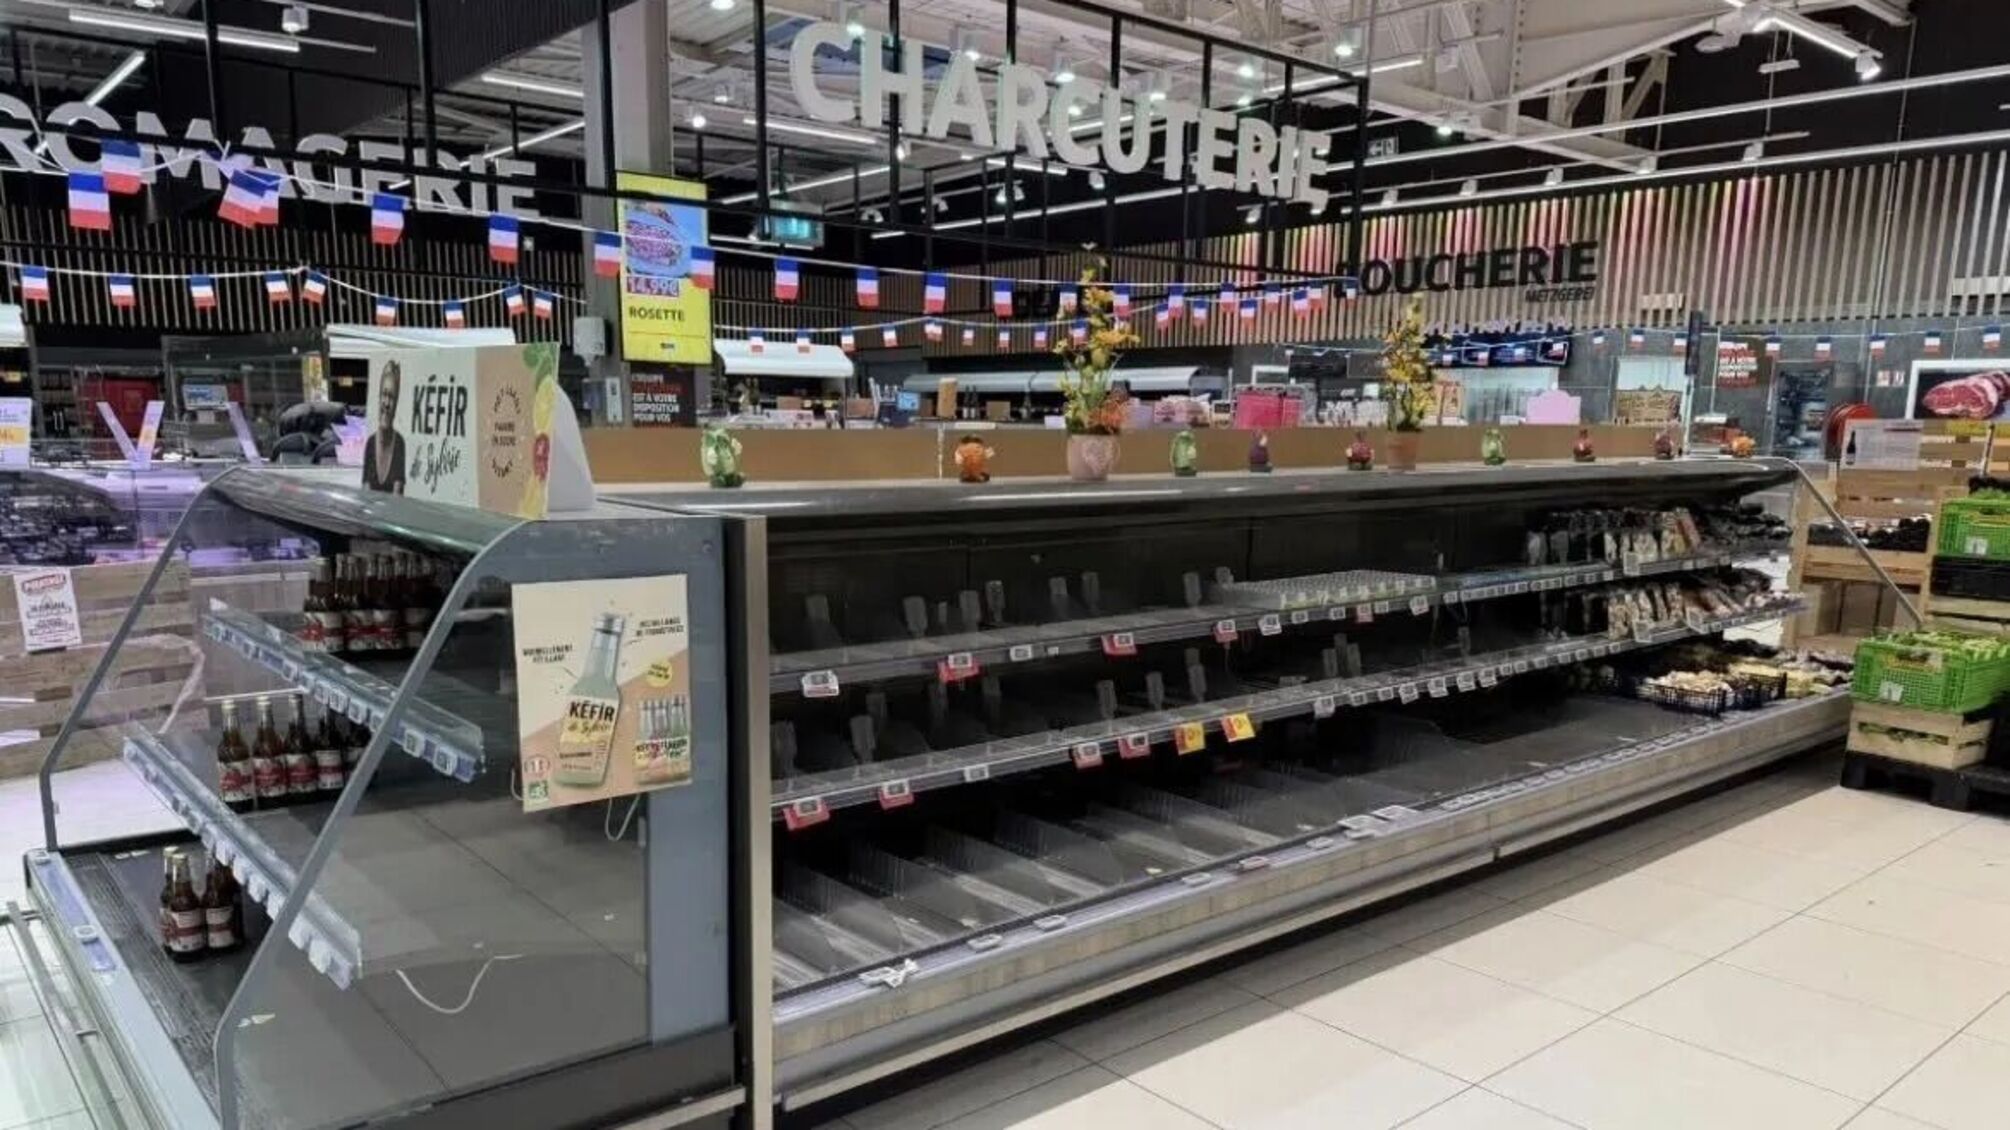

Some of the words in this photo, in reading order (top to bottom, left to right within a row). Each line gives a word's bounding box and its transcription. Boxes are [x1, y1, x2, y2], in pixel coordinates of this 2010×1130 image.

[790, 22, 1330, 201] CHARCUTERIE
[629, 306, 685, 322] ROSETTE
[411, 374, 467, 437] KÉFIR
[569, 701, 615, 721] KÉFIR
